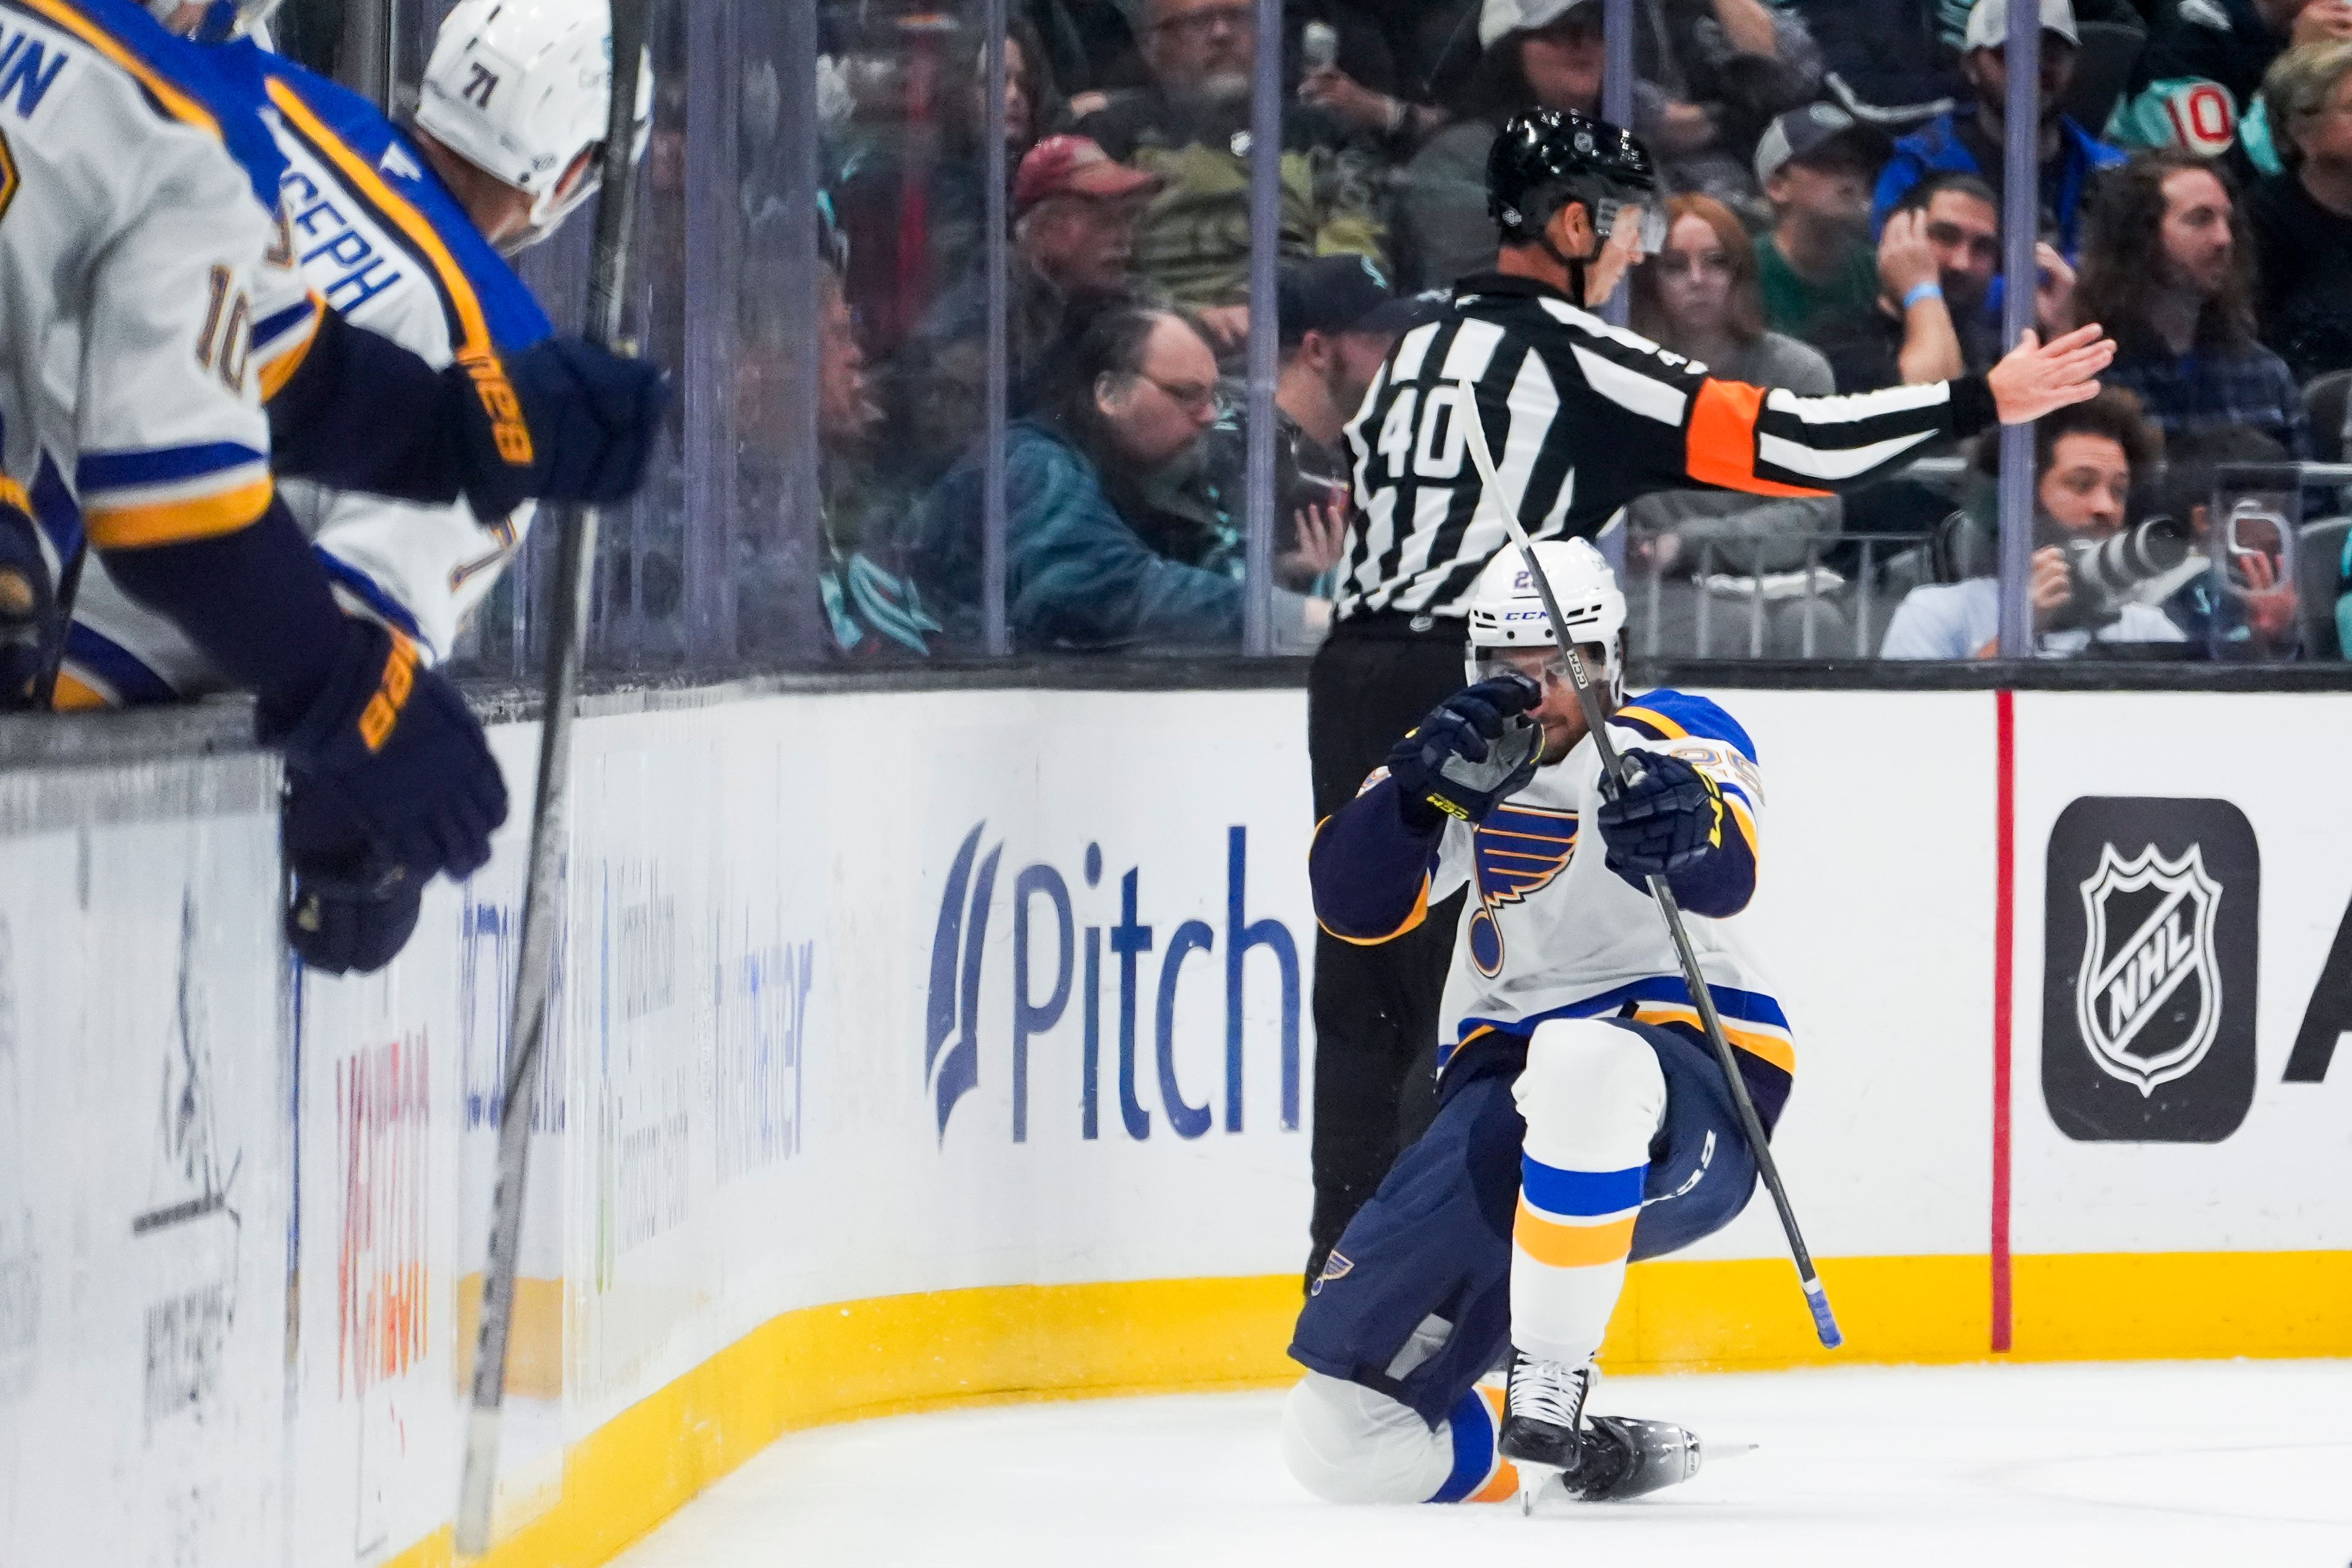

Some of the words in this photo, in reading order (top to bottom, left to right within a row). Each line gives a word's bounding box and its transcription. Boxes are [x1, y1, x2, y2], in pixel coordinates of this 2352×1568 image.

[462, 62, 500, 110] 71
[2163, 85, 2231, 149] 10
[1377, 385, 1469, 479] 40
[1513, 570, 1537, 589] 2
[1568, 652, 1588, 685] CCM
[1013, 825, 1301, 1143] Pitch
[2108, 911, 2193, 1038] NHL
